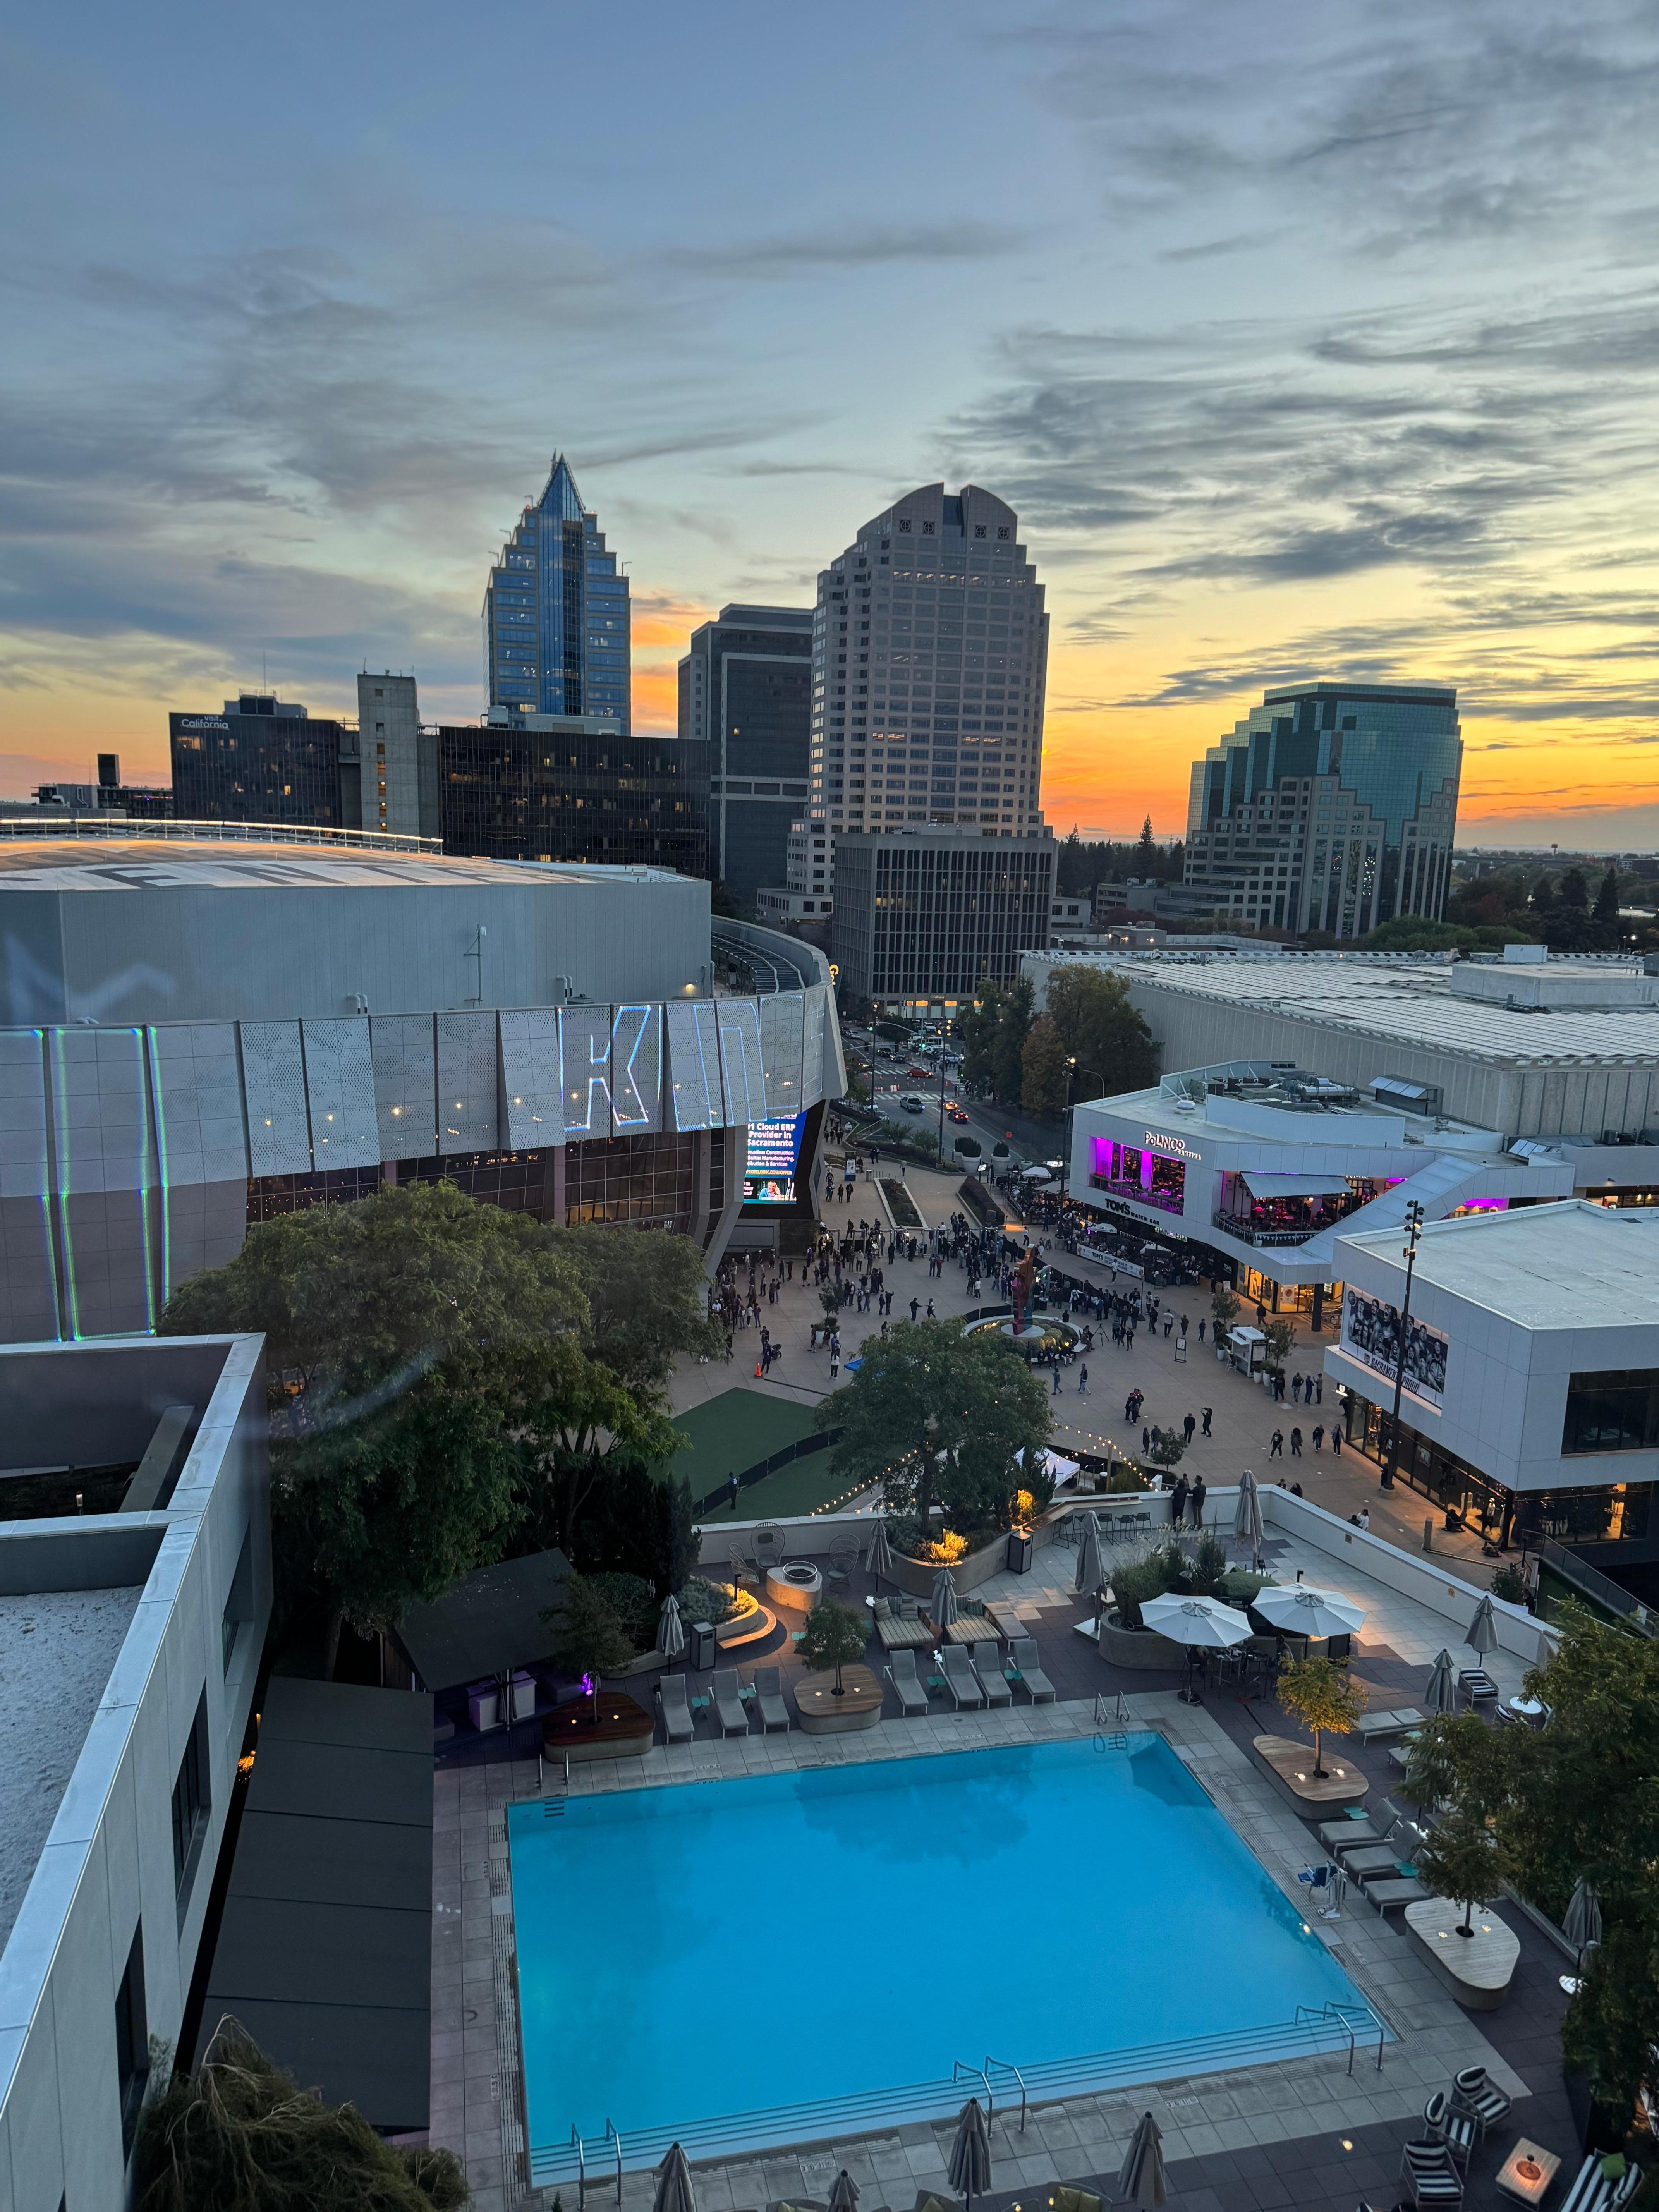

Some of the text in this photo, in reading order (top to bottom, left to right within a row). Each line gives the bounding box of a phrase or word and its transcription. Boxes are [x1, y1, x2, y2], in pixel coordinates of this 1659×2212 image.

[182, 719, 228, 729] California
[749, 1130, 792, 1139] Provider in
[747, 1139, 794, 1147] Sacramento
[1105, 1198, 1130, 1215] TOM'S
[1130, 1212, 1147, 1221] WATCH
[1370, 1358, 1398, 1382] SACRAMEN
[1402, 1376, 1419, 1394] PROUD
